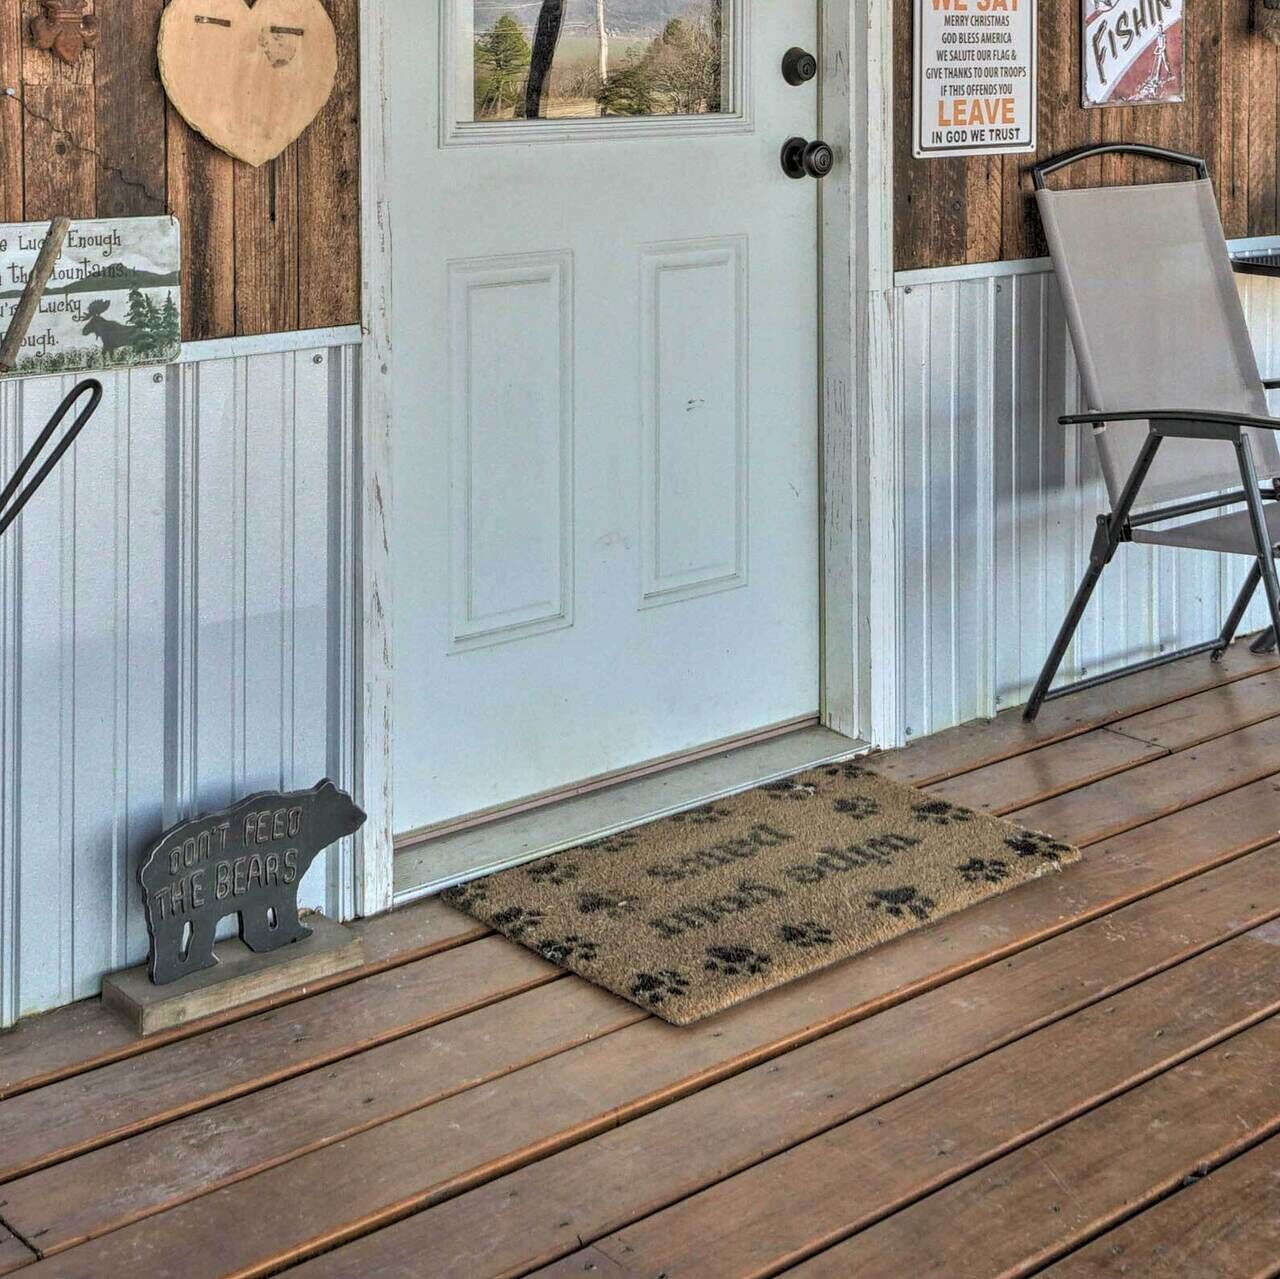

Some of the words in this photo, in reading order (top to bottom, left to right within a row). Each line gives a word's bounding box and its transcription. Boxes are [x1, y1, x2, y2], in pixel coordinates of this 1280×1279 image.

[944, 15, 969, 26] MERRY
[970, 15, 1010, 26] CHRISTMAS
[942, 32, 957, 44] GOD
[959, 32, 979, 44] BLESS
[981, 32, 1012, 44] AMERICA
[936, 50, 948, 61] WE
[949, 50, 975, 61] SALUTE
[977, 50, 991, 61] OUR
[993, 50, 1009, 60] FLAG
[1011, 49, 1017, 60] &
[926, 68, 942, 79] GIVE
[944, 67, 972, 79] THANKS
[974, 67, 982, 78] TO
[984, 67, 999, 78] OUR
[1000, 67, 1027, 78] TROOPS
[941, 85, 947, 96] IF
[949, 85, 965, 96] THIS
[966, 84, 997, 96] OFFENDS
[999, 84, 1013, 95] YOU
[938, 98, 1015, 126] LEAVE
[932, 131, 942, 143] IN
[946, 130, 967, 143] GOD
[971, 130, 985, 142] WE
[989, 128, 1021, 140] TRUST
[67, 229, 122, 257] Enough
[6, 262, 30, 283] th
[39, 294, 81, 322] Lucky
[0, 329, 59, 357] ough.
[169, 821, 230, 875] DON'T
[242, 806, 303, 848] FEED
[785, 833, 922, 882] wipe
[155, 869, 205, 919] THE
[216, 848, 299, 900] BEARS
